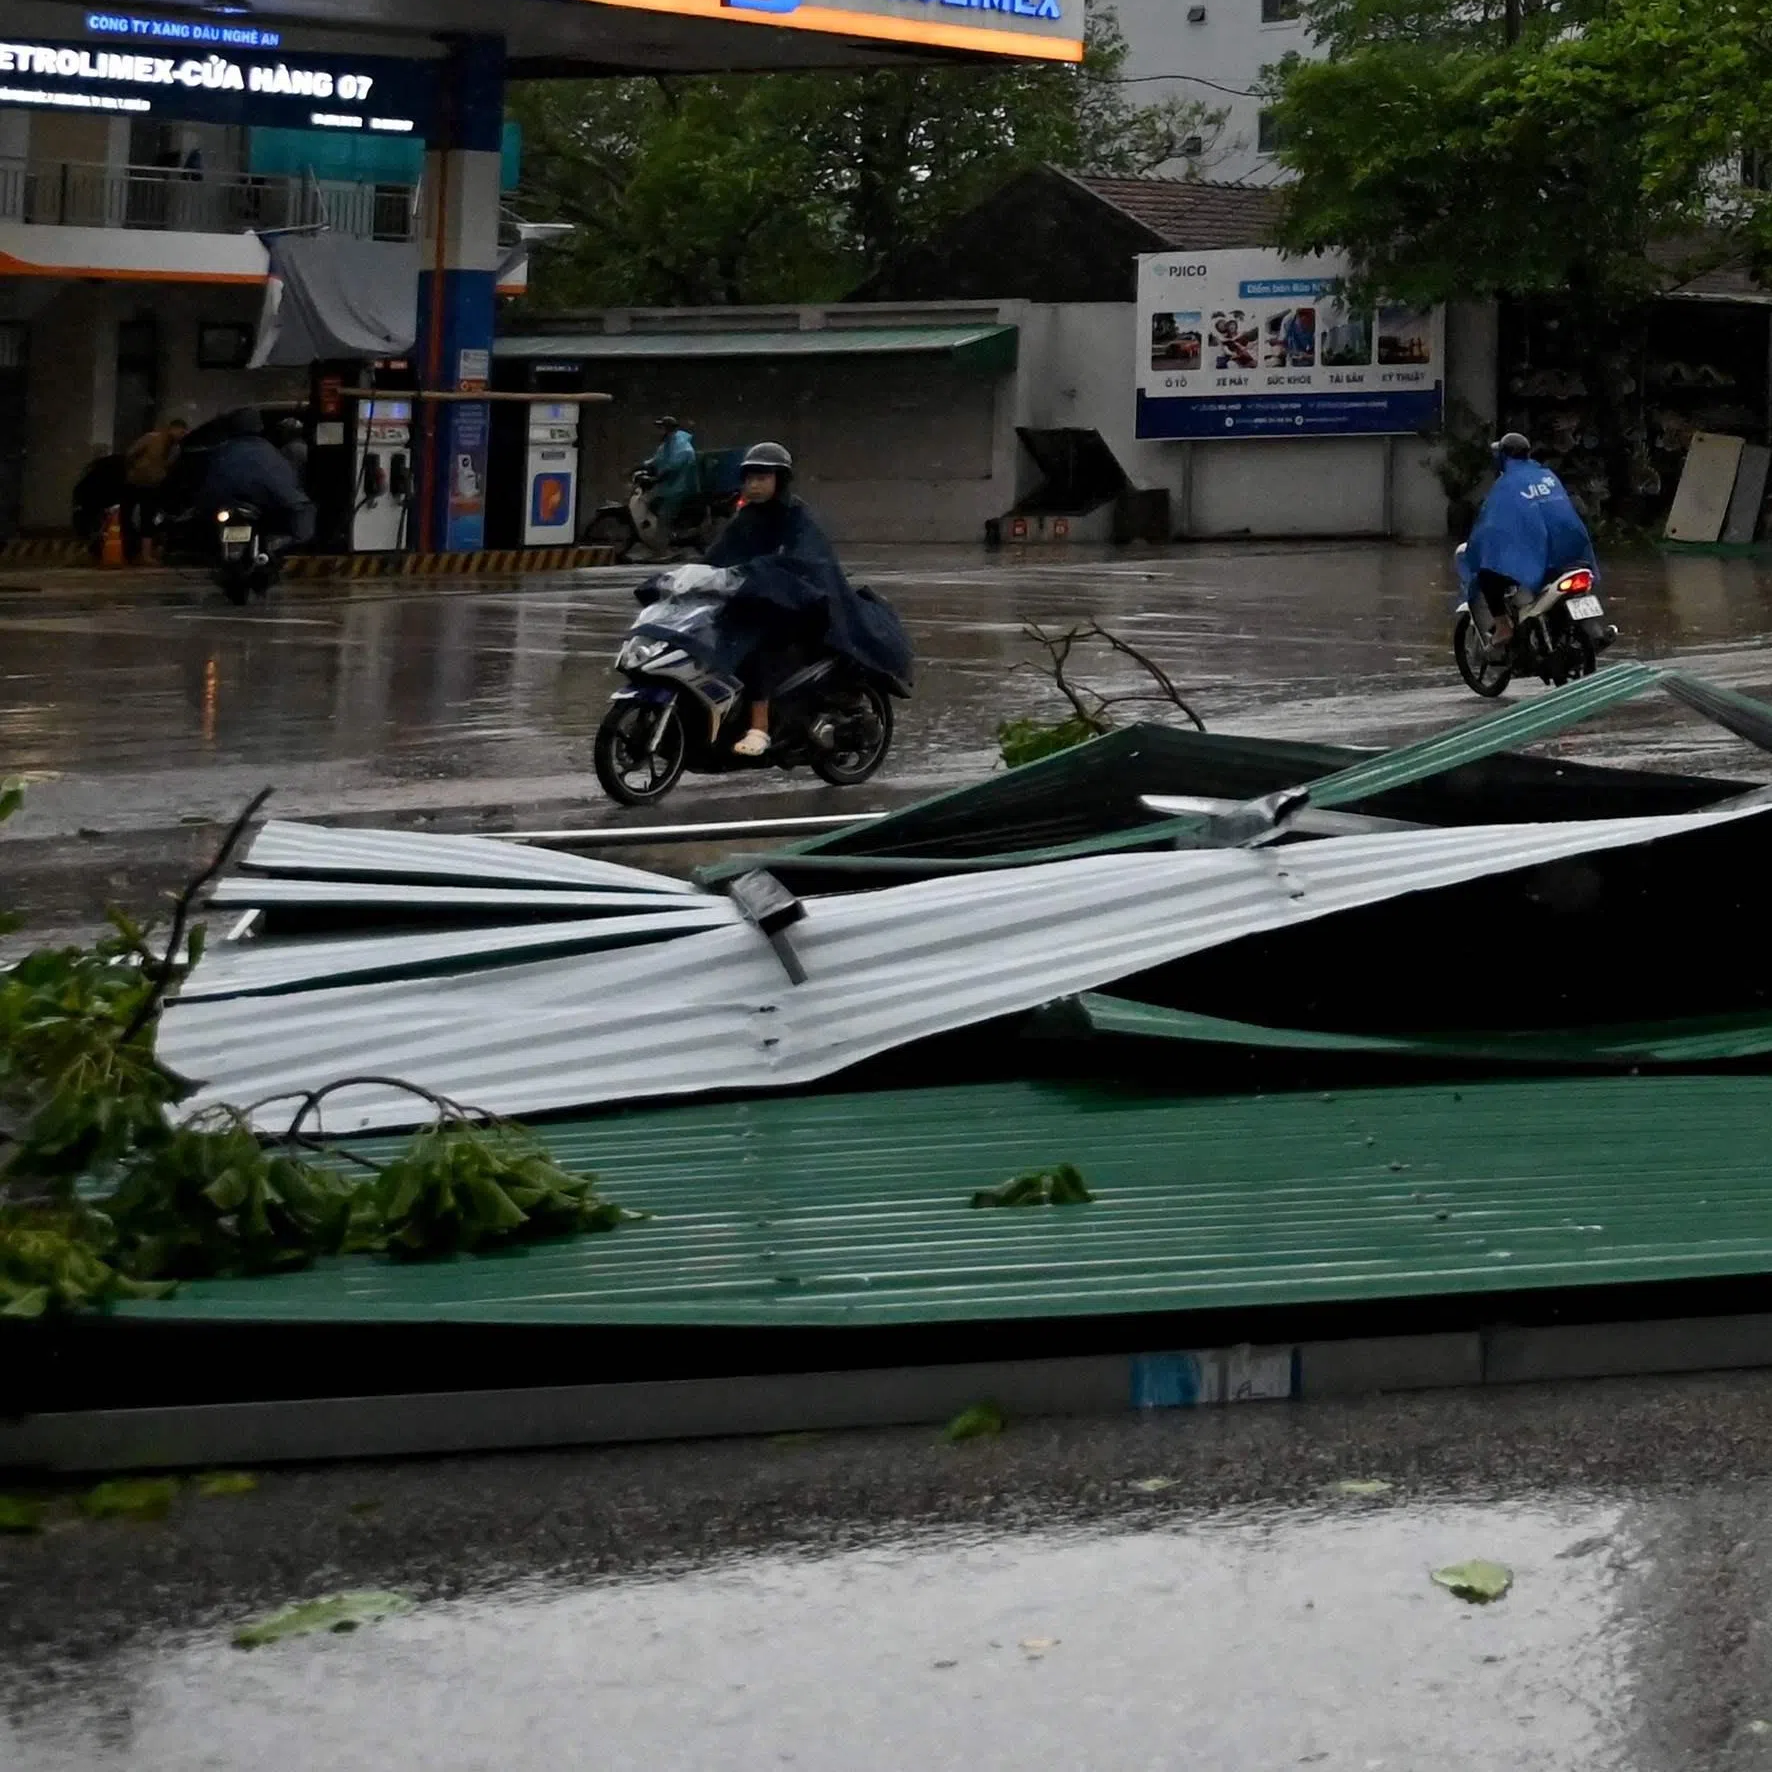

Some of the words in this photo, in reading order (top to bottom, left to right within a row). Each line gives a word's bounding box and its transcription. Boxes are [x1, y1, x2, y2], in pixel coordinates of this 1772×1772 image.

[132, 19, 150, 34] TY
[261, 33, 279, 46] AN
[250, 64, 333, 97] HÀNG
[338, 75, 373, 99] 07
[1169, 264, 1208, 277] PJICO
